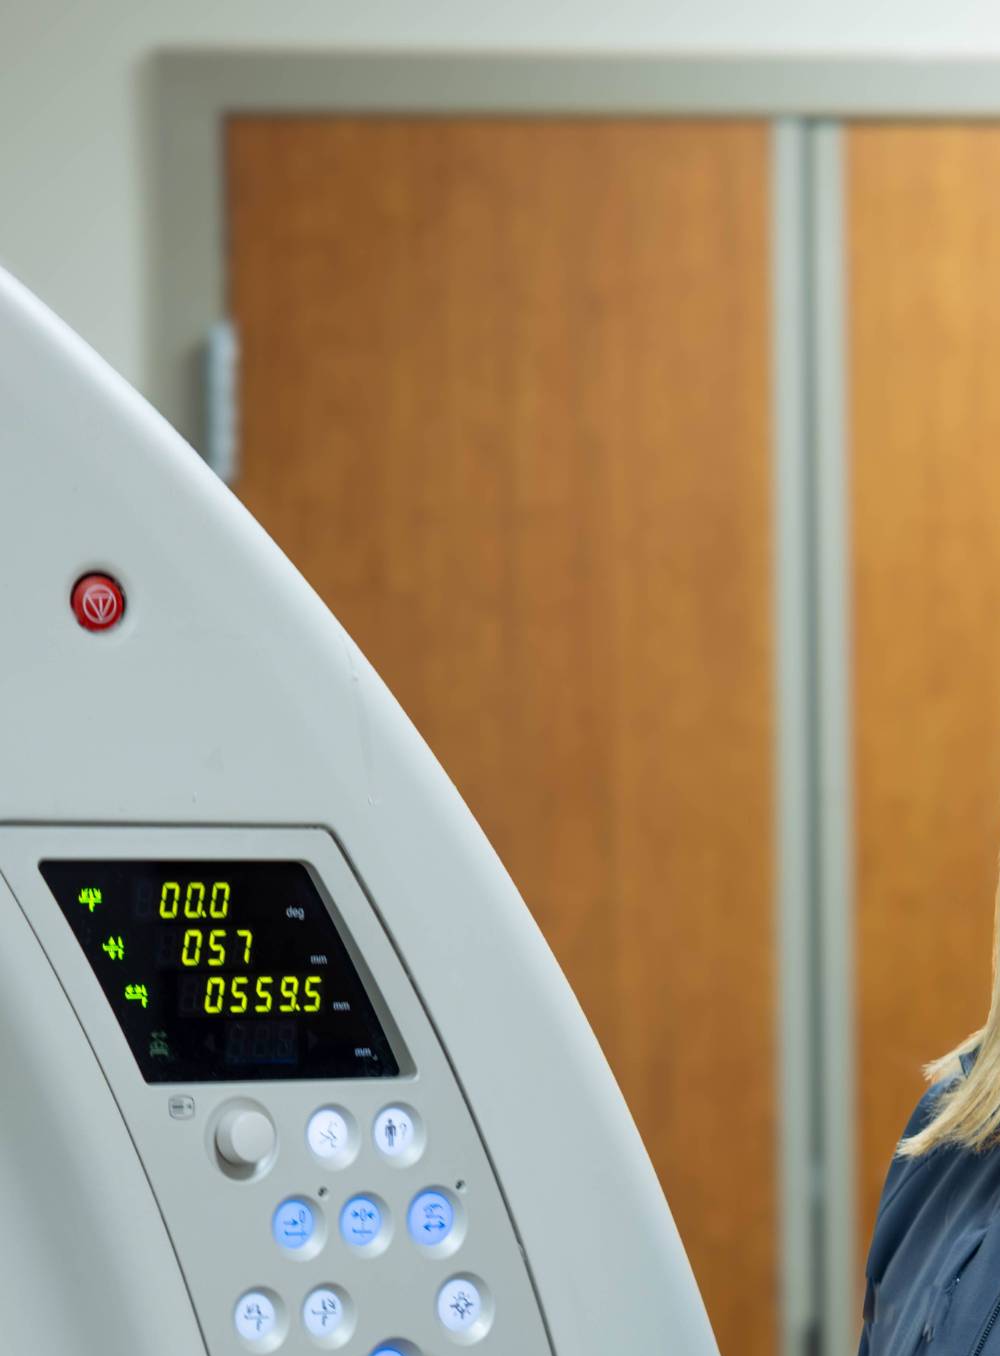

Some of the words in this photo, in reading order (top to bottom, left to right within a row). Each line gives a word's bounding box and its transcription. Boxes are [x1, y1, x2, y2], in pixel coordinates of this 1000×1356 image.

[160, 882, 230, 919] 00.0
[286, 905, 305, 920] deg
[182, 930, 253, 966] 057
[310, 954, 328, 965] mm
[204, 976, 322, 1014] 0559.5
[333, 1001, 351, 1011] mm
